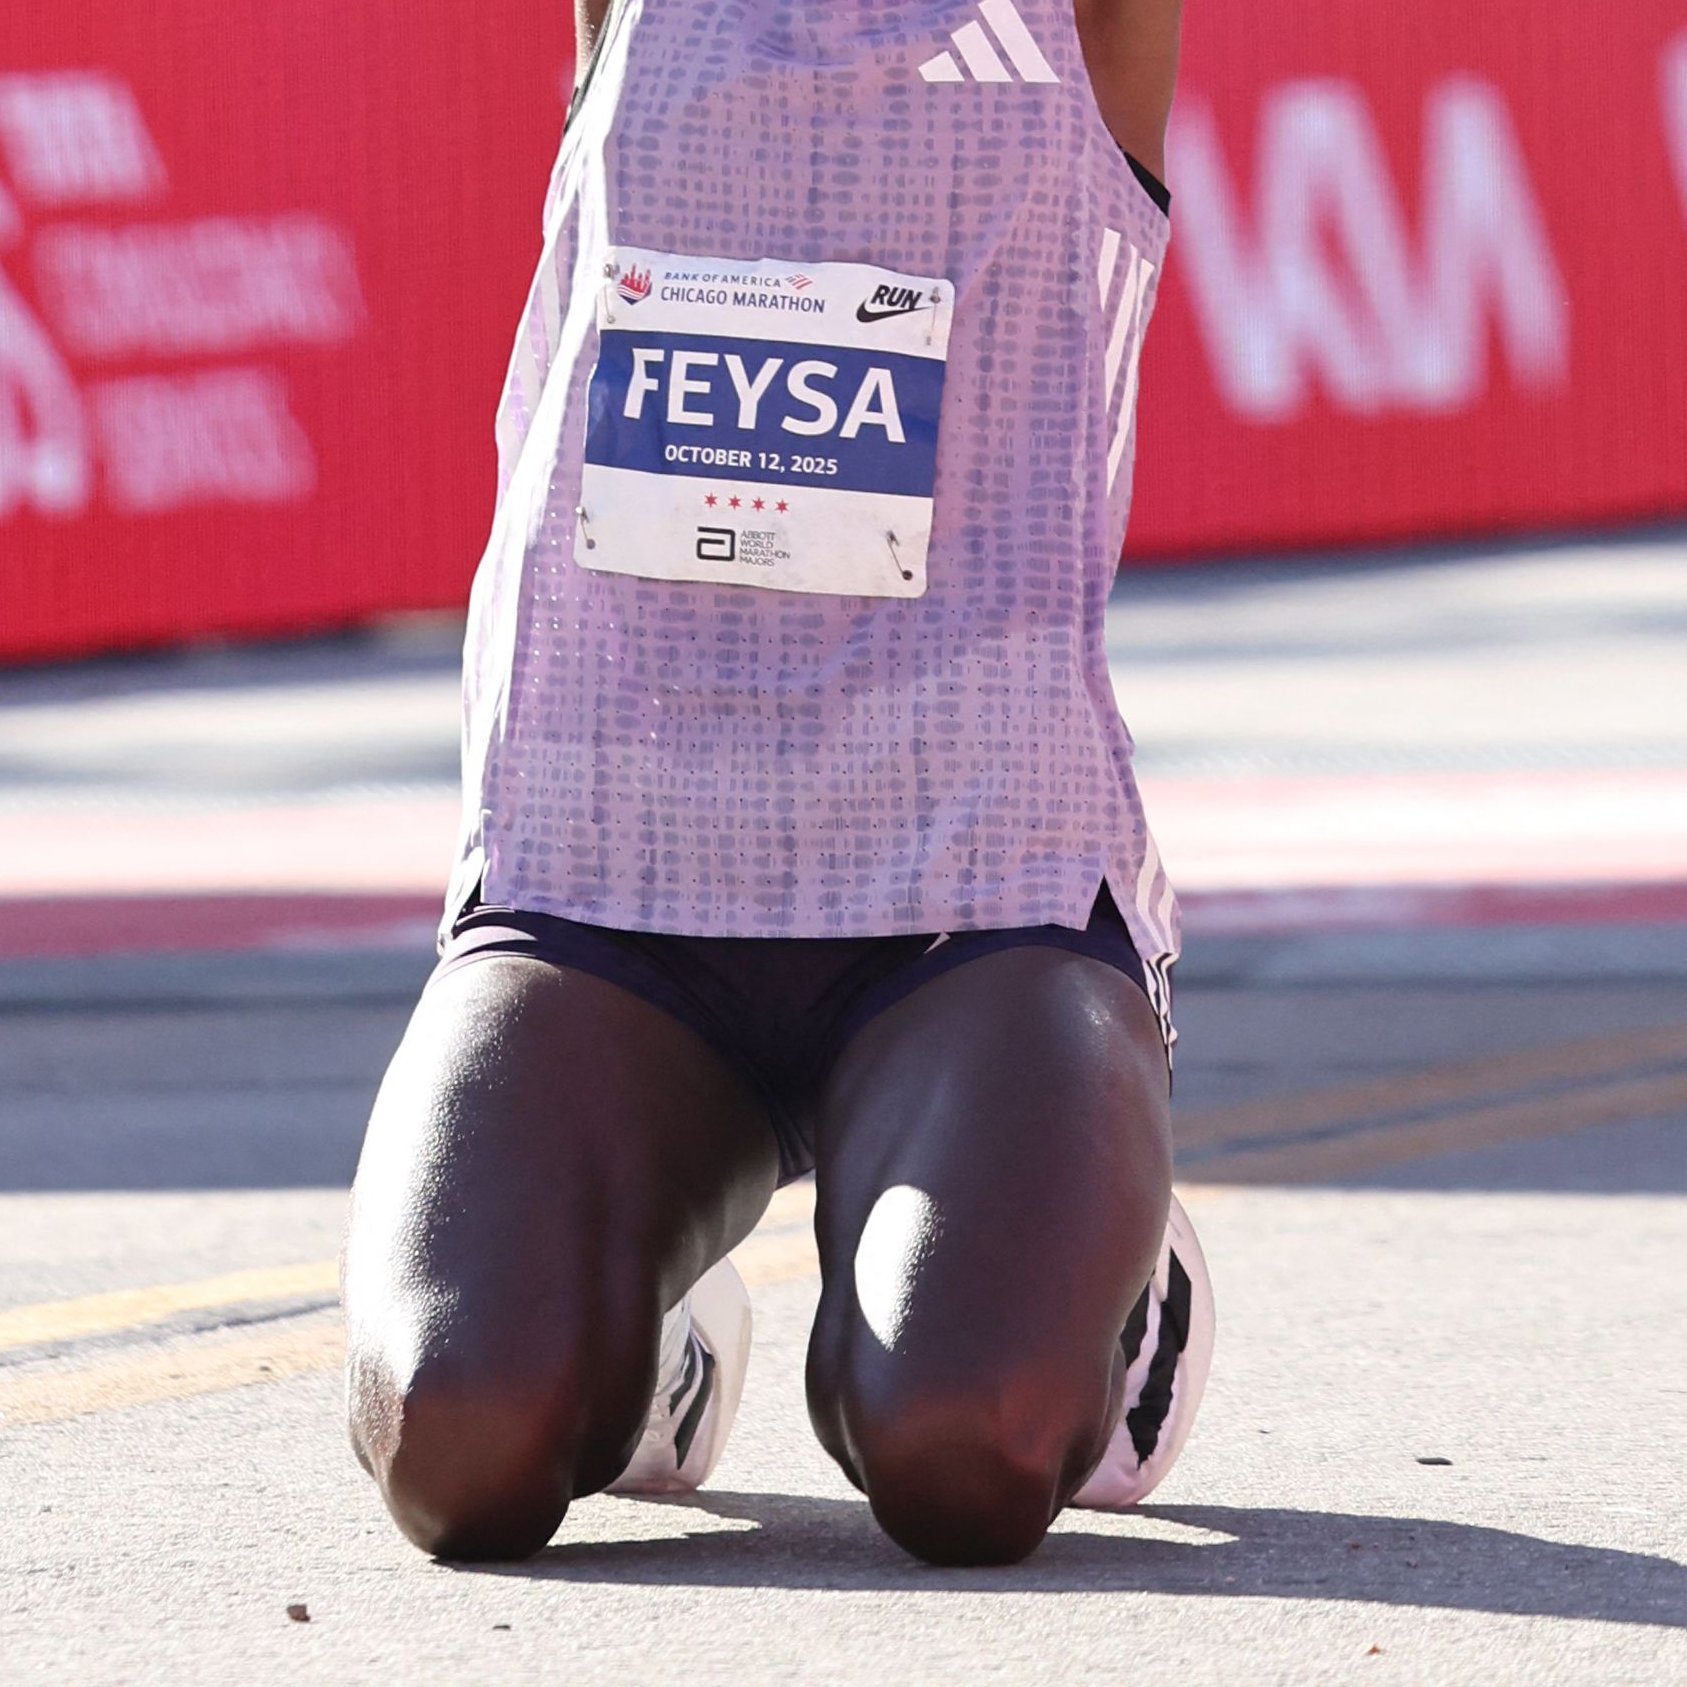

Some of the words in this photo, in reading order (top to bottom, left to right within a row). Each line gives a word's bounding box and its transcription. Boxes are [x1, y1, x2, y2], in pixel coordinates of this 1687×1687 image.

[664, 271, 698, 281] BANK
[702, 273, 719, 283] OF
[721, 274, 782, 288] AMERICA
[660, 286, 728, 305] CHICAGO
[732, 291, 825, 313] MARATHON
[870, 284, 923, 310] RUN
[622, 347, 906, 443] FEYSA
[665, 444, 752, 468] OCTOBER
[759, 452, 786, 474] 12,
[790, 455, 839, 475] 2025
[740, 530, 776, 541] ABBOTT
[740, 539, 774, 549] WORLD
[739, 548, 790, 559] MARATHON
[739, 556, 775, 567] MAJORS
